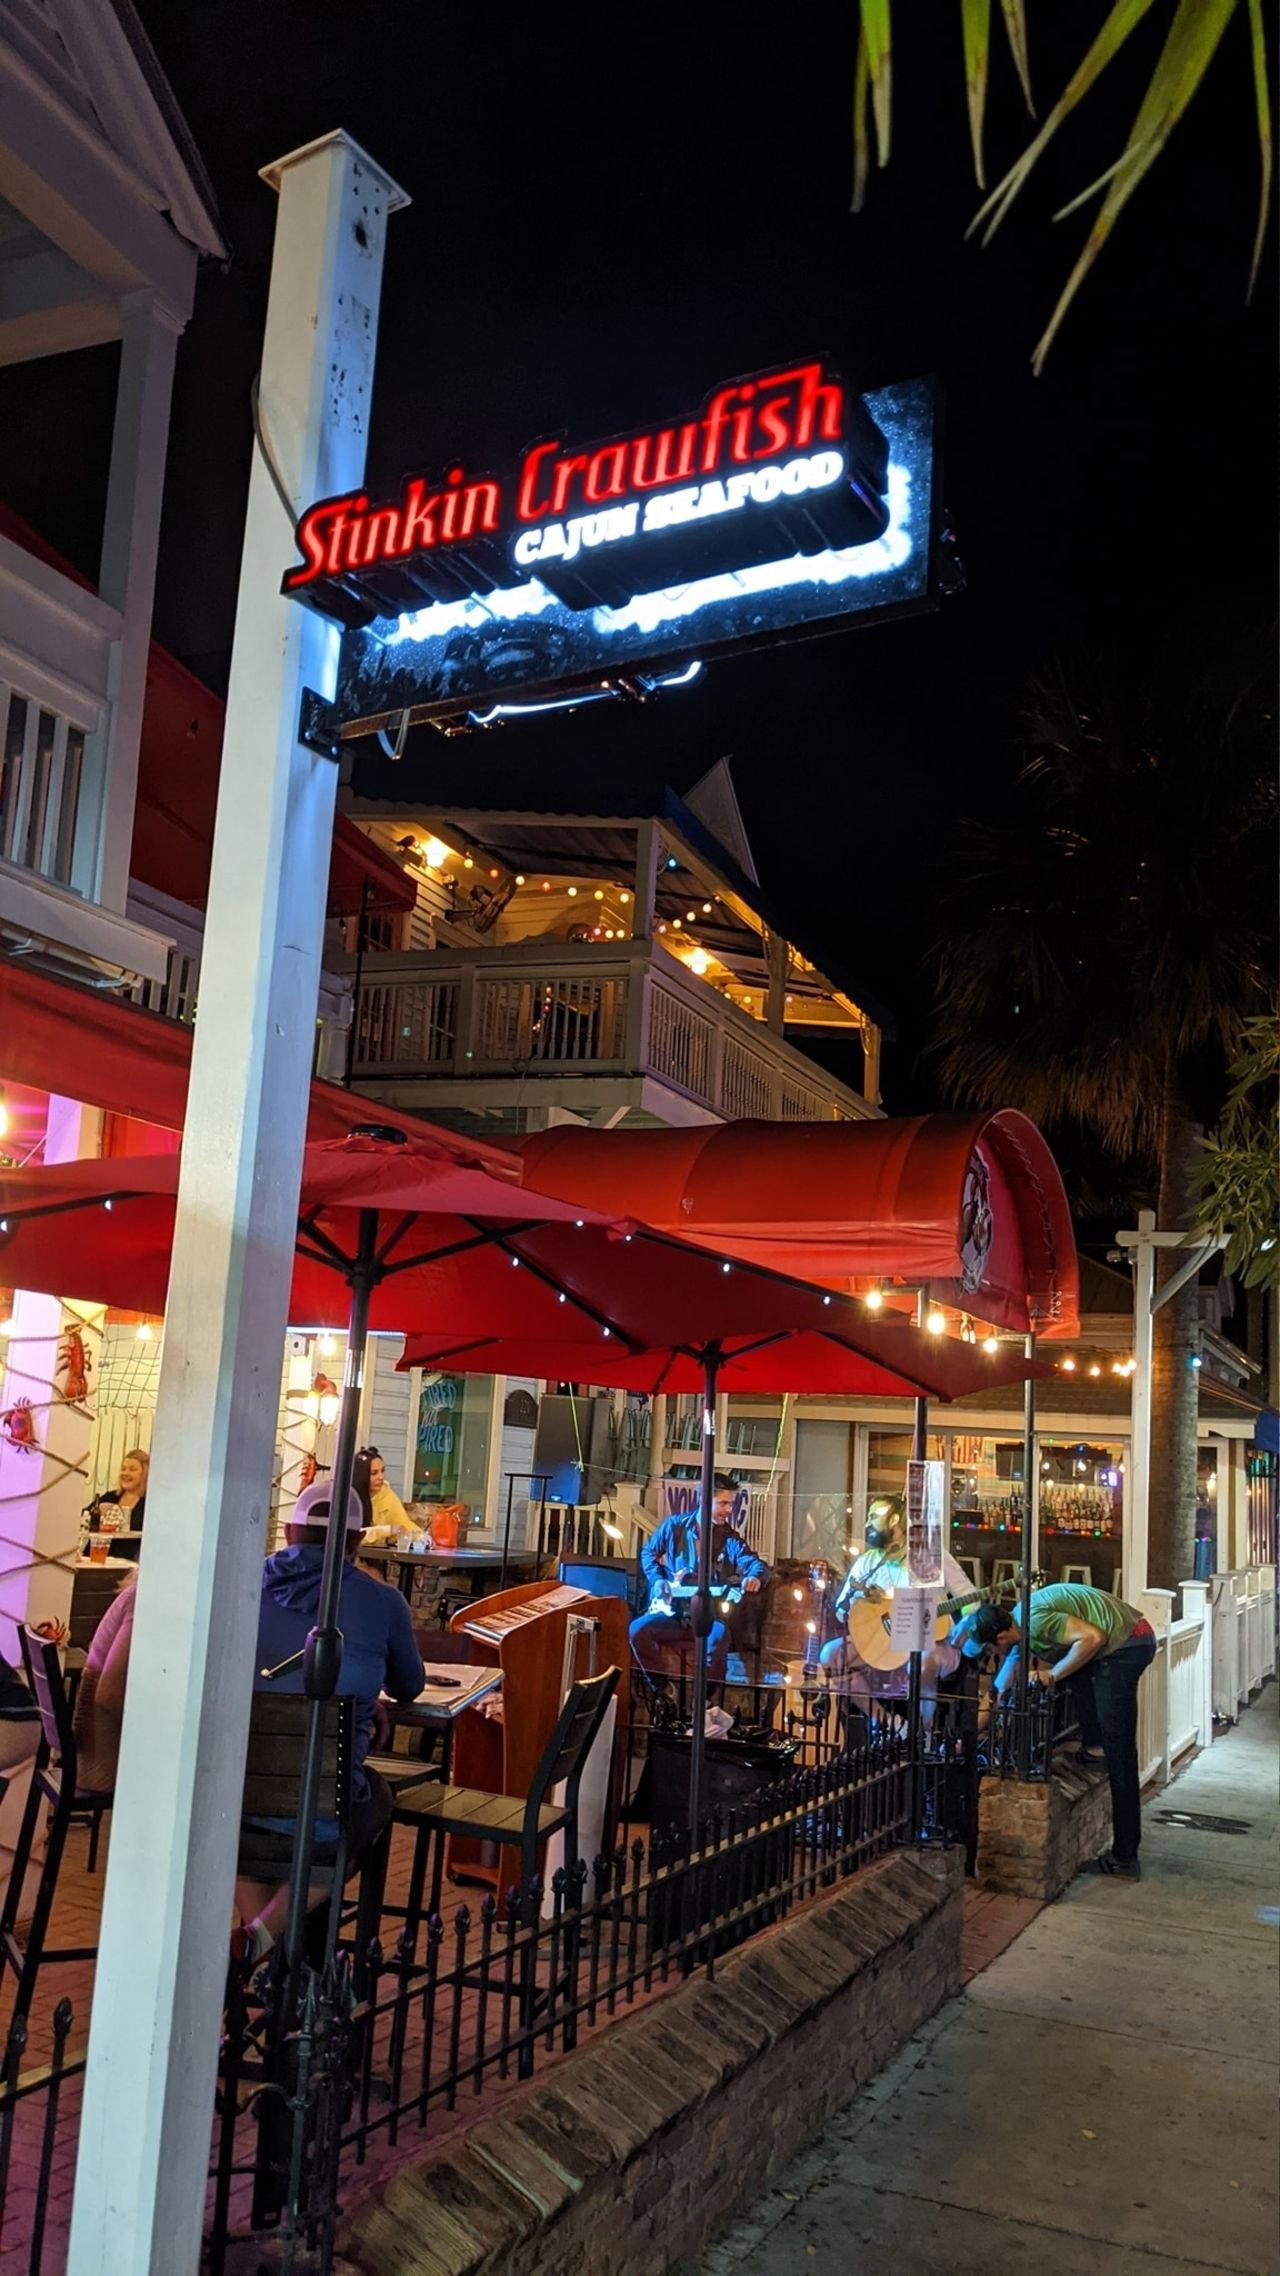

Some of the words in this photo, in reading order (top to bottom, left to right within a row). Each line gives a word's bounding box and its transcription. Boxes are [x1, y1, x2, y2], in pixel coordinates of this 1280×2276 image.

[289, 469, 502, 587] Stinkin
[516, 363, 844, 522] Crawfish
[513, 502, 640, 565] CAJUN
[642, 450, 845, 532] SEAFOOD
